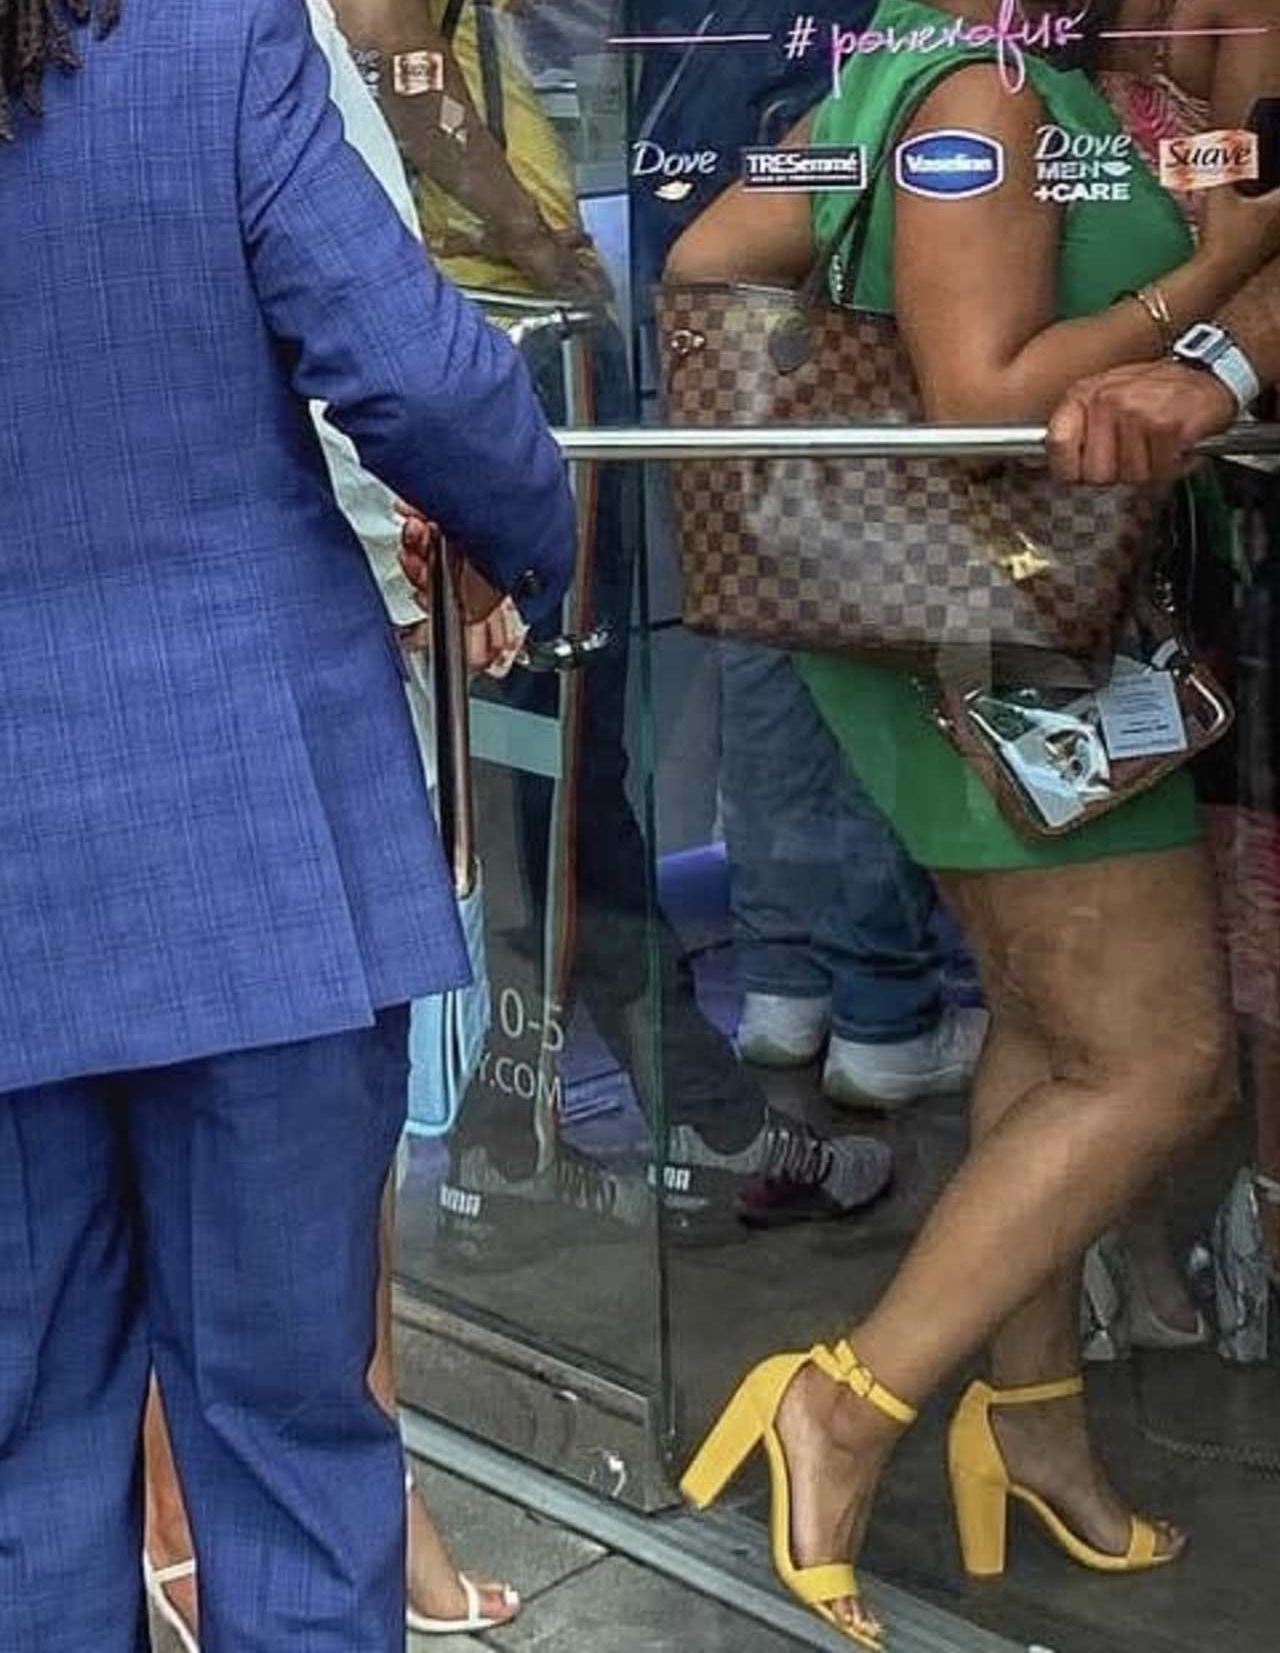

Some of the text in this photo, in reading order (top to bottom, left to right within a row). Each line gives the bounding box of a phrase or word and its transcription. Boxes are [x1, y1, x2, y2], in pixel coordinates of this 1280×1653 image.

[1034, 123, 1133, 161] Dove
[1165, 139, 1252, 170] Suave
[631, 140, 719, 177] Dove
[1036, 161, 1100, 181] MEN
[1034, 183, 1132, 203] +CARE
